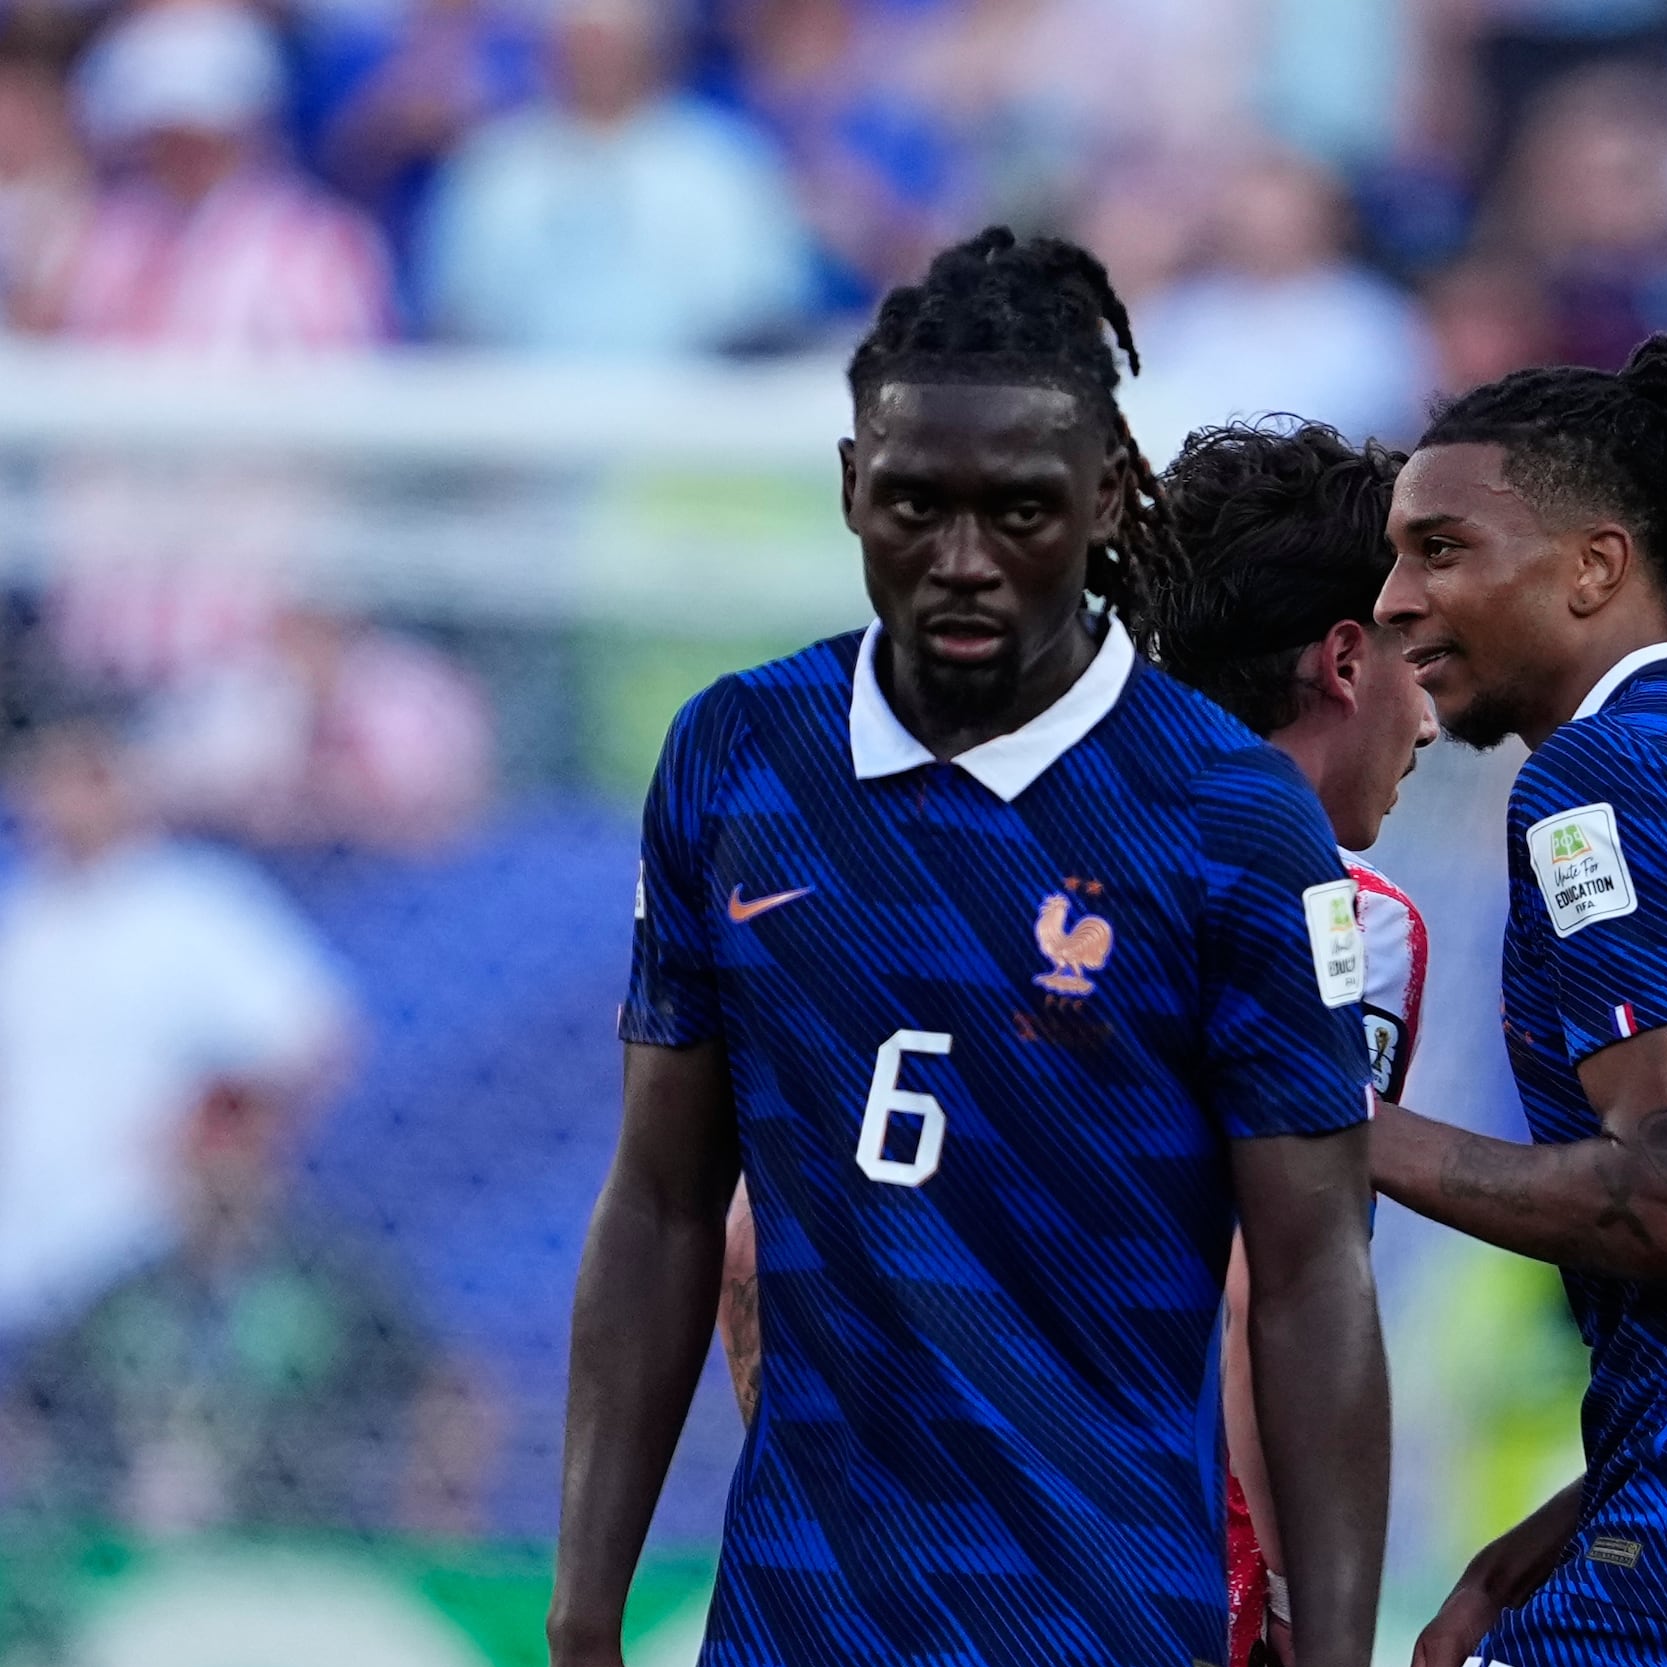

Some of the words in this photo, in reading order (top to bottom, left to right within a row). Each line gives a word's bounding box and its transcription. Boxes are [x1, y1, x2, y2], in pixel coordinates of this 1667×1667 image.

[1554, 864, 1581, 888] Unite
[1580, 856, 1599, 877] For
[1554, 875, 1615, 910] EDUCATION
[1574, 899, 1596, 914] FIFA
[855, 1028, 953, 1188] 6
